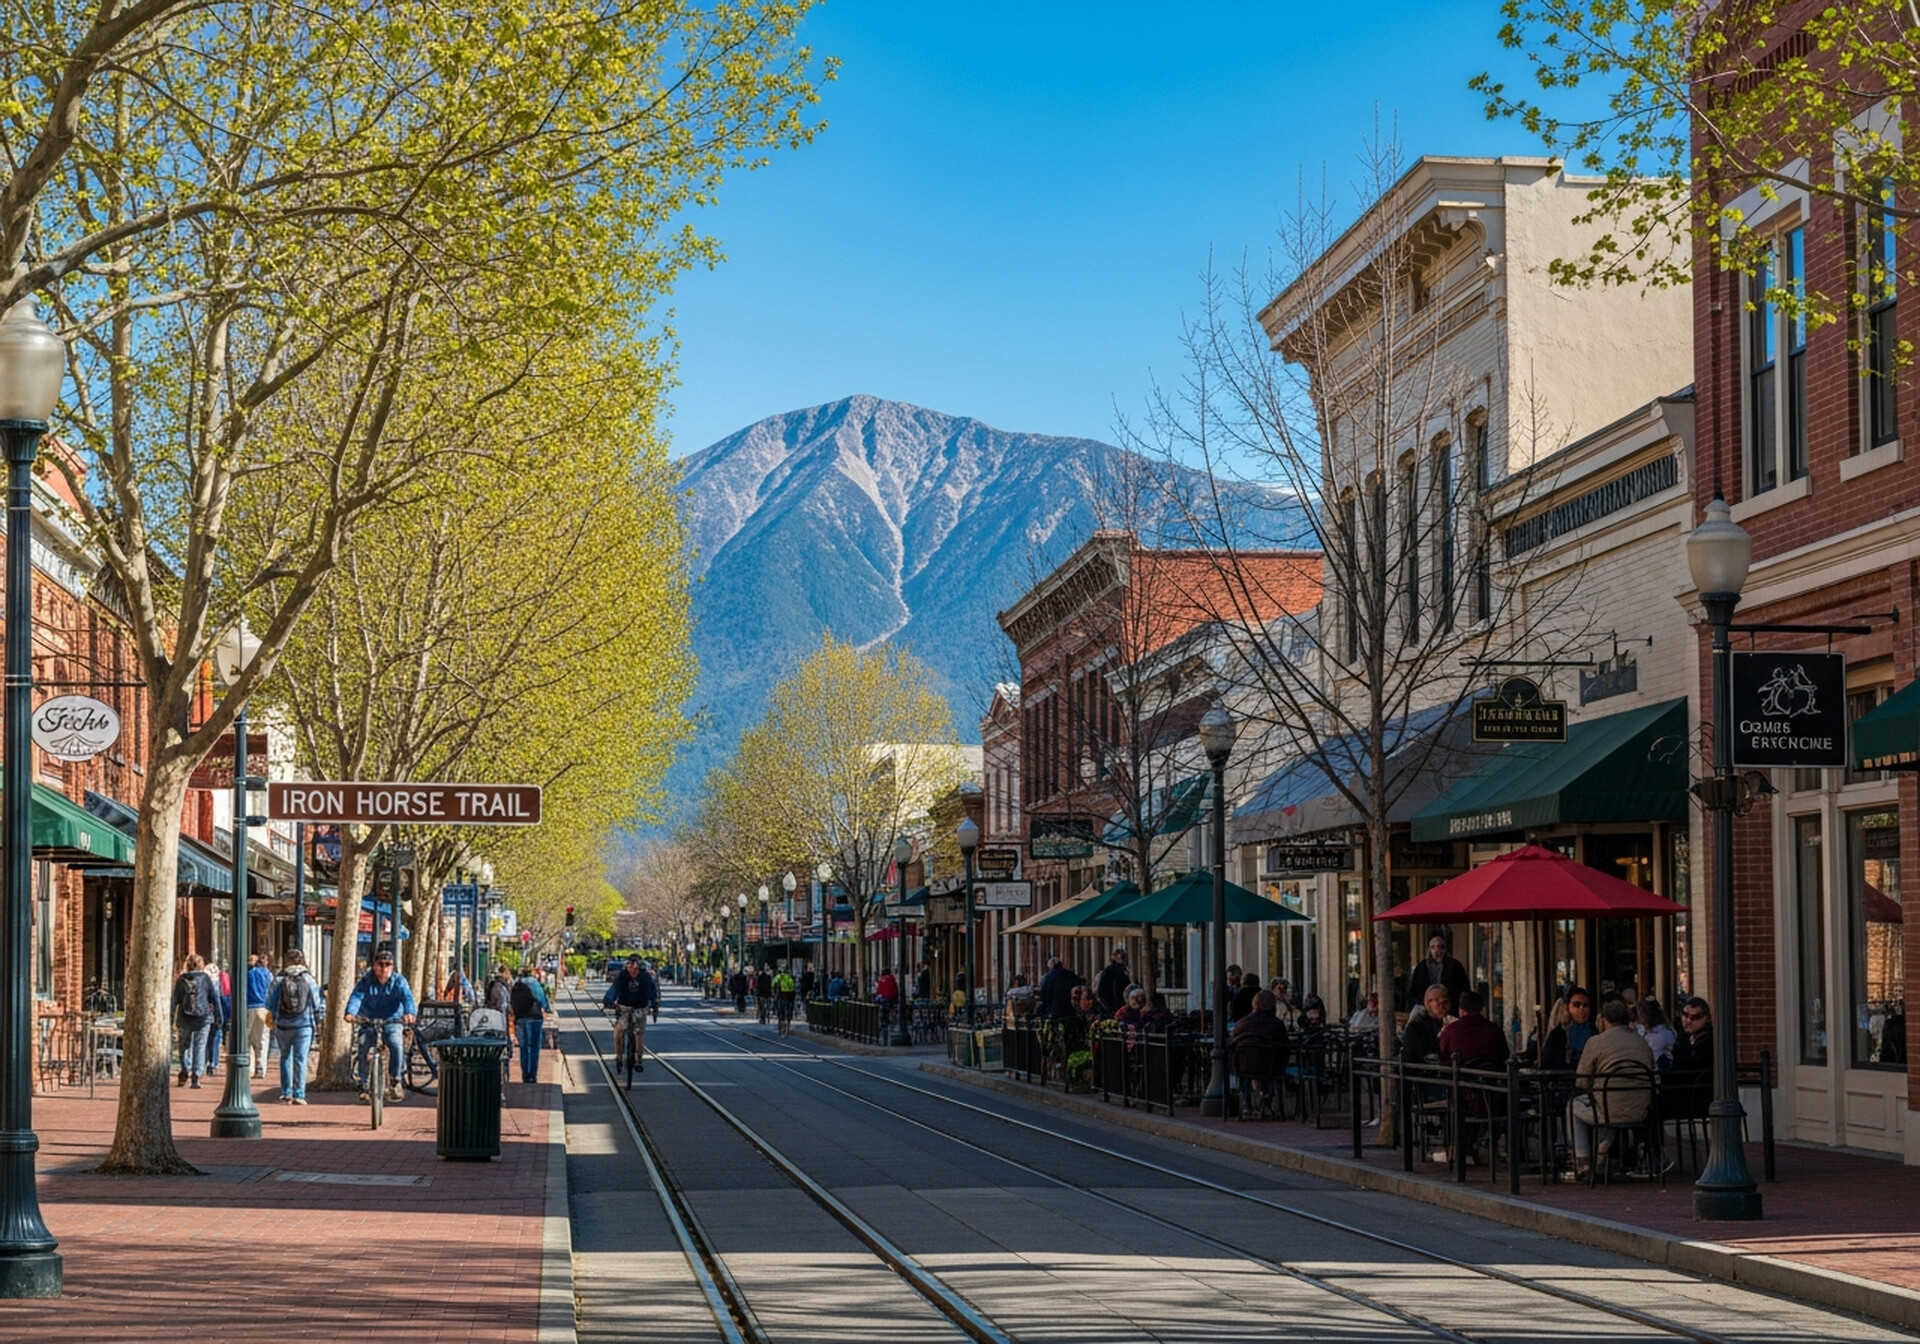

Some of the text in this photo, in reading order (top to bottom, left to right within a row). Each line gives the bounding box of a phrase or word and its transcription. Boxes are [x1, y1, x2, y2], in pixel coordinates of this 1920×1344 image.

[282, 789, 530, 817] IRON HORSE TRAIL
